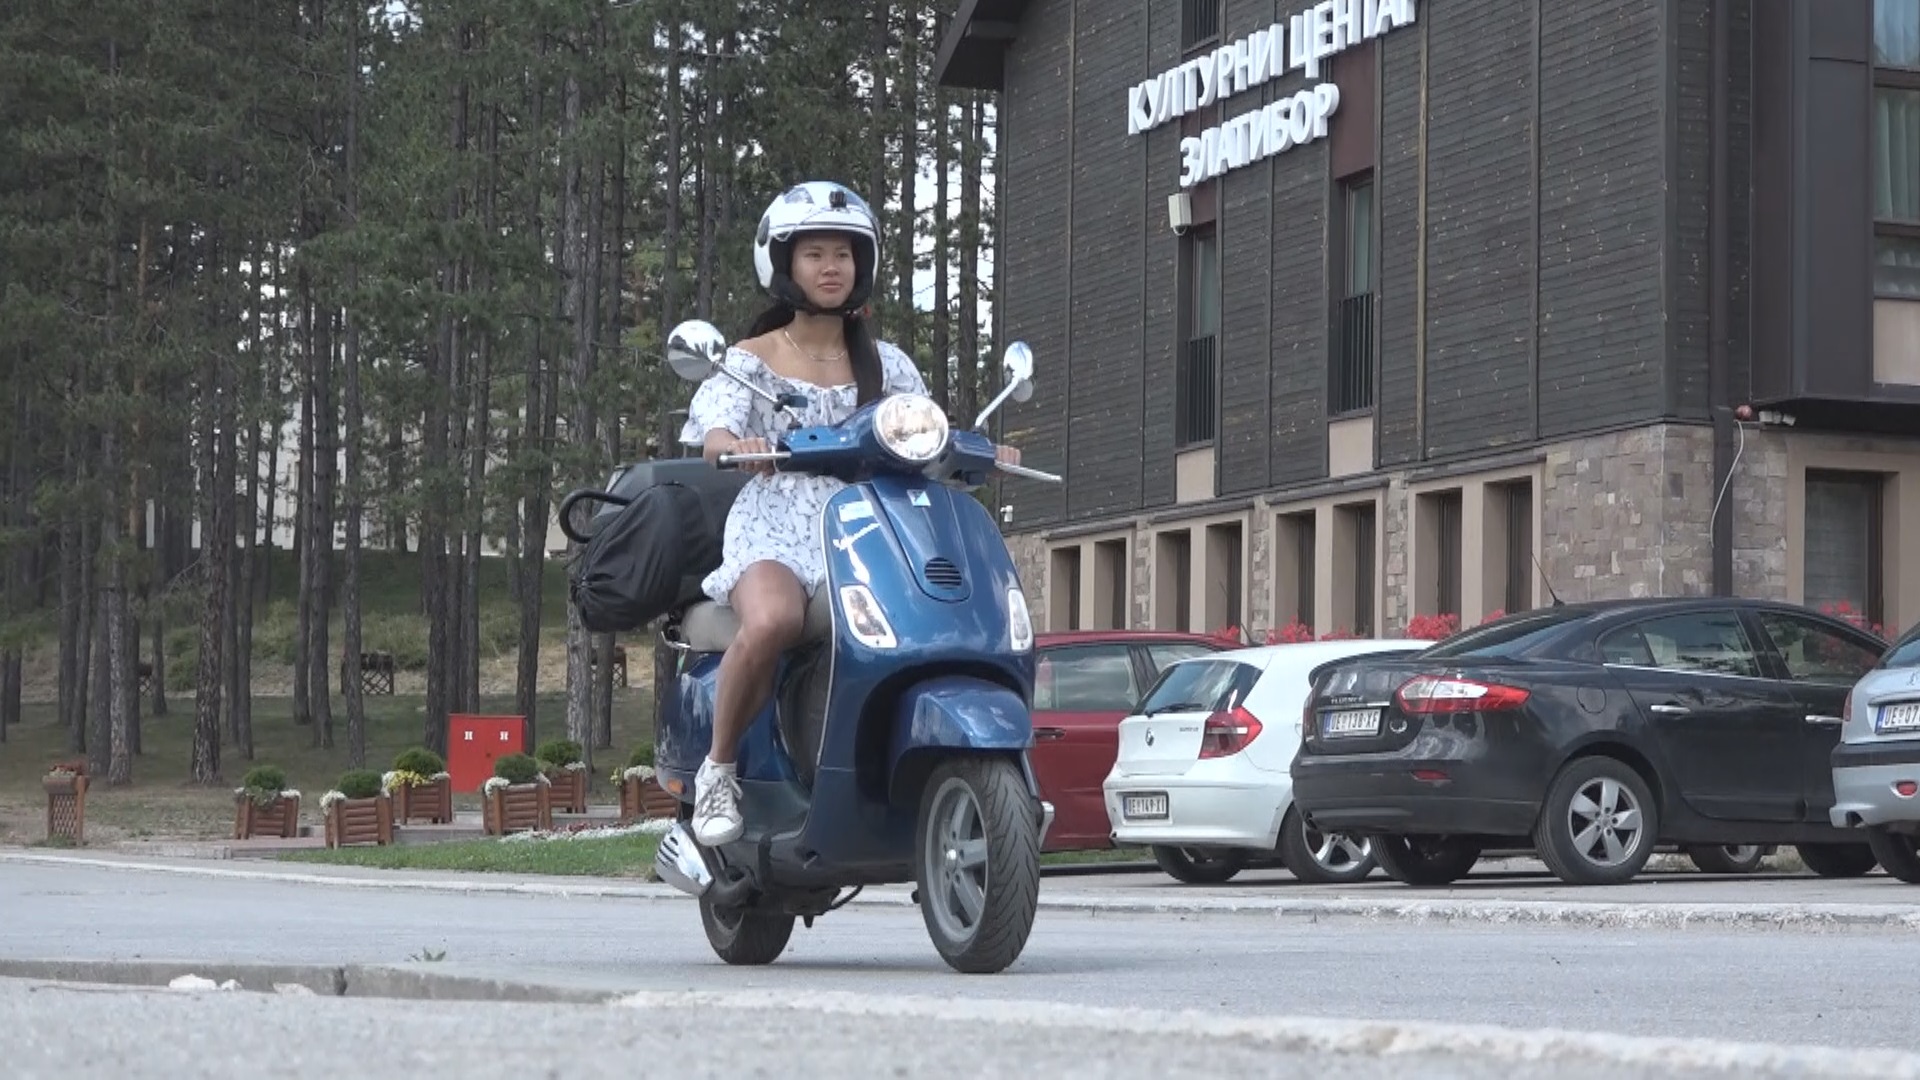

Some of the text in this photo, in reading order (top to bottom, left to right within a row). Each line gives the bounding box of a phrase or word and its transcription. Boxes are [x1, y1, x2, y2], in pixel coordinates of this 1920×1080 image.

[1128, 23, 1284, 135] КУЛТУРНИ
[1180, 82, 1340, 188] ЗЛАТИБОР
[1905, 704, 1920, 724] 07
